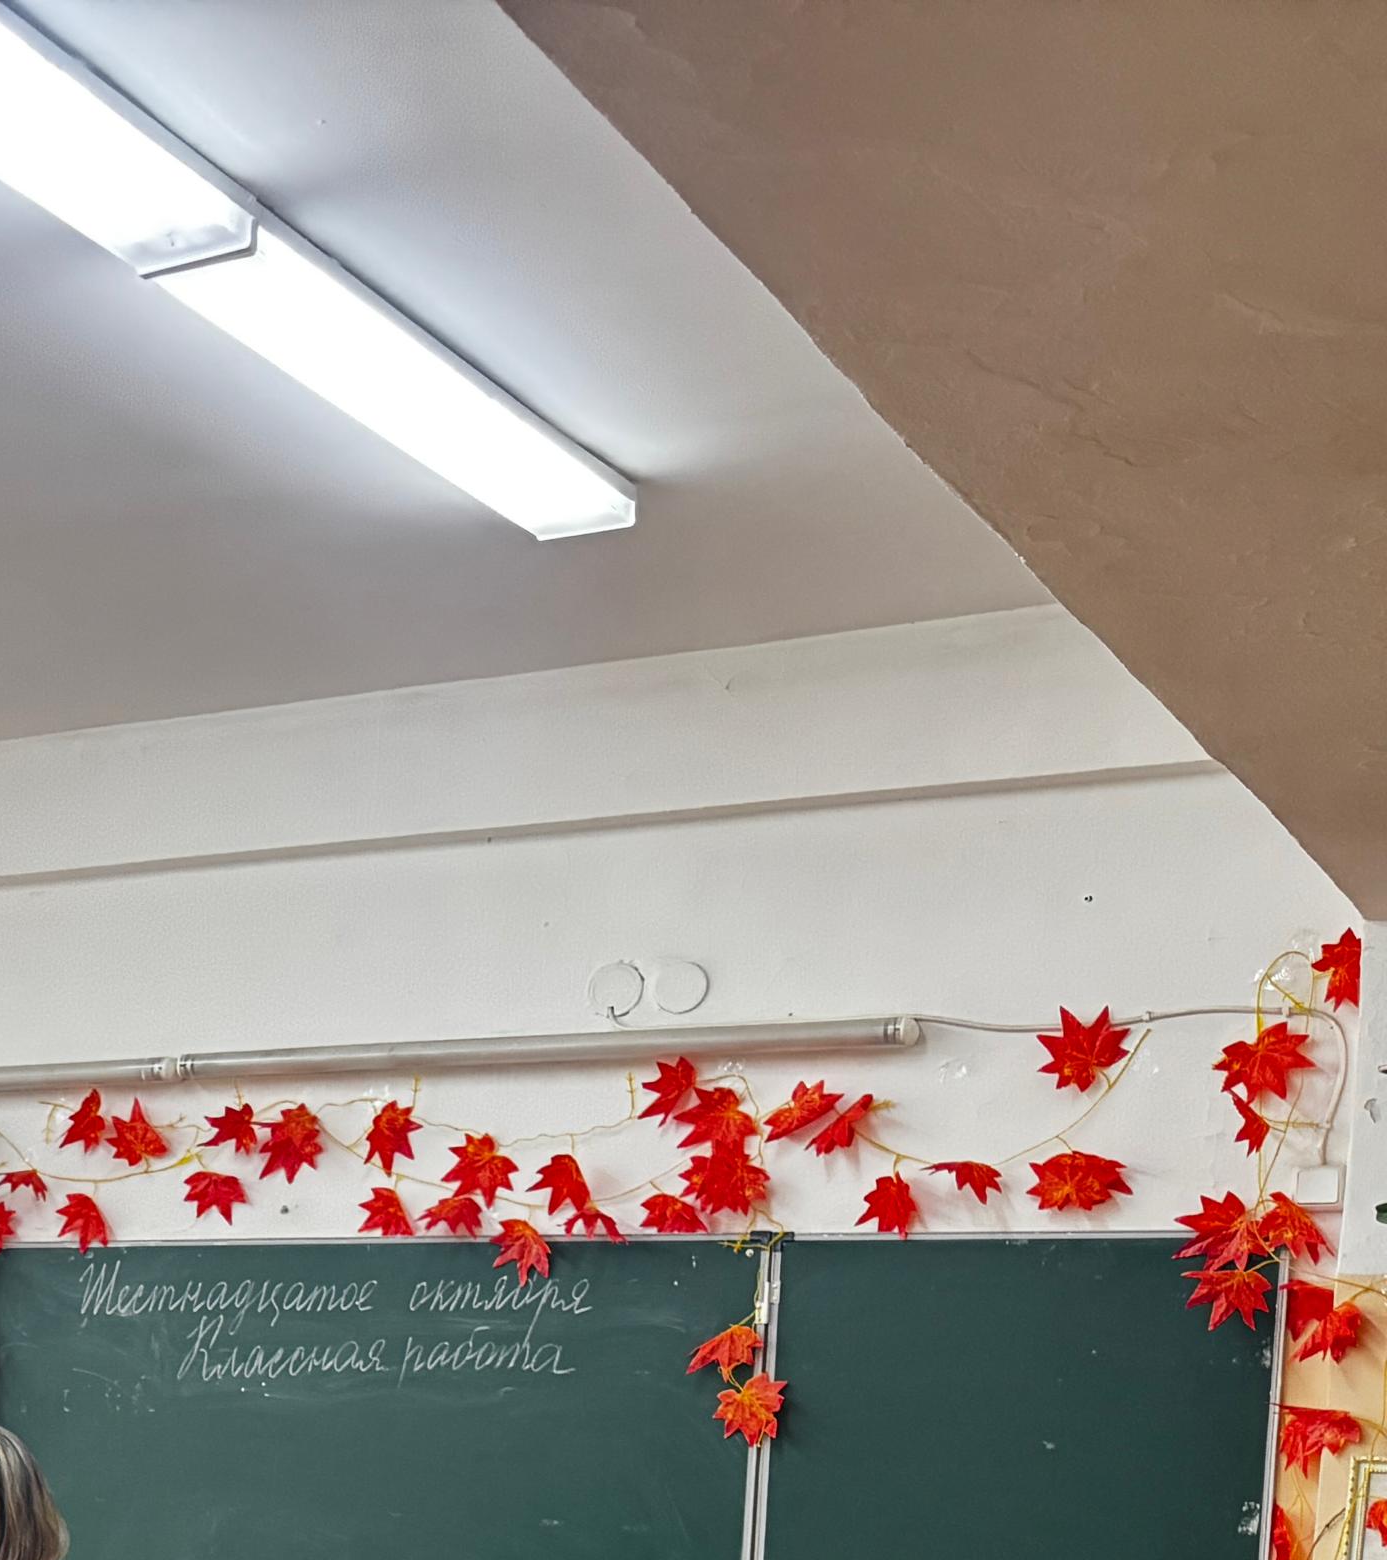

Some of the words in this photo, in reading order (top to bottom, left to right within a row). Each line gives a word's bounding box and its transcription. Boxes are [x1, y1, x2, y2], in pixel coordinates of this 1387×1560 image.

[78, 1260, 378, 1335] Шестнадцатое
[177, 1314, 390, 1381] Классная
[397, 1326, 576, 1388] работа
